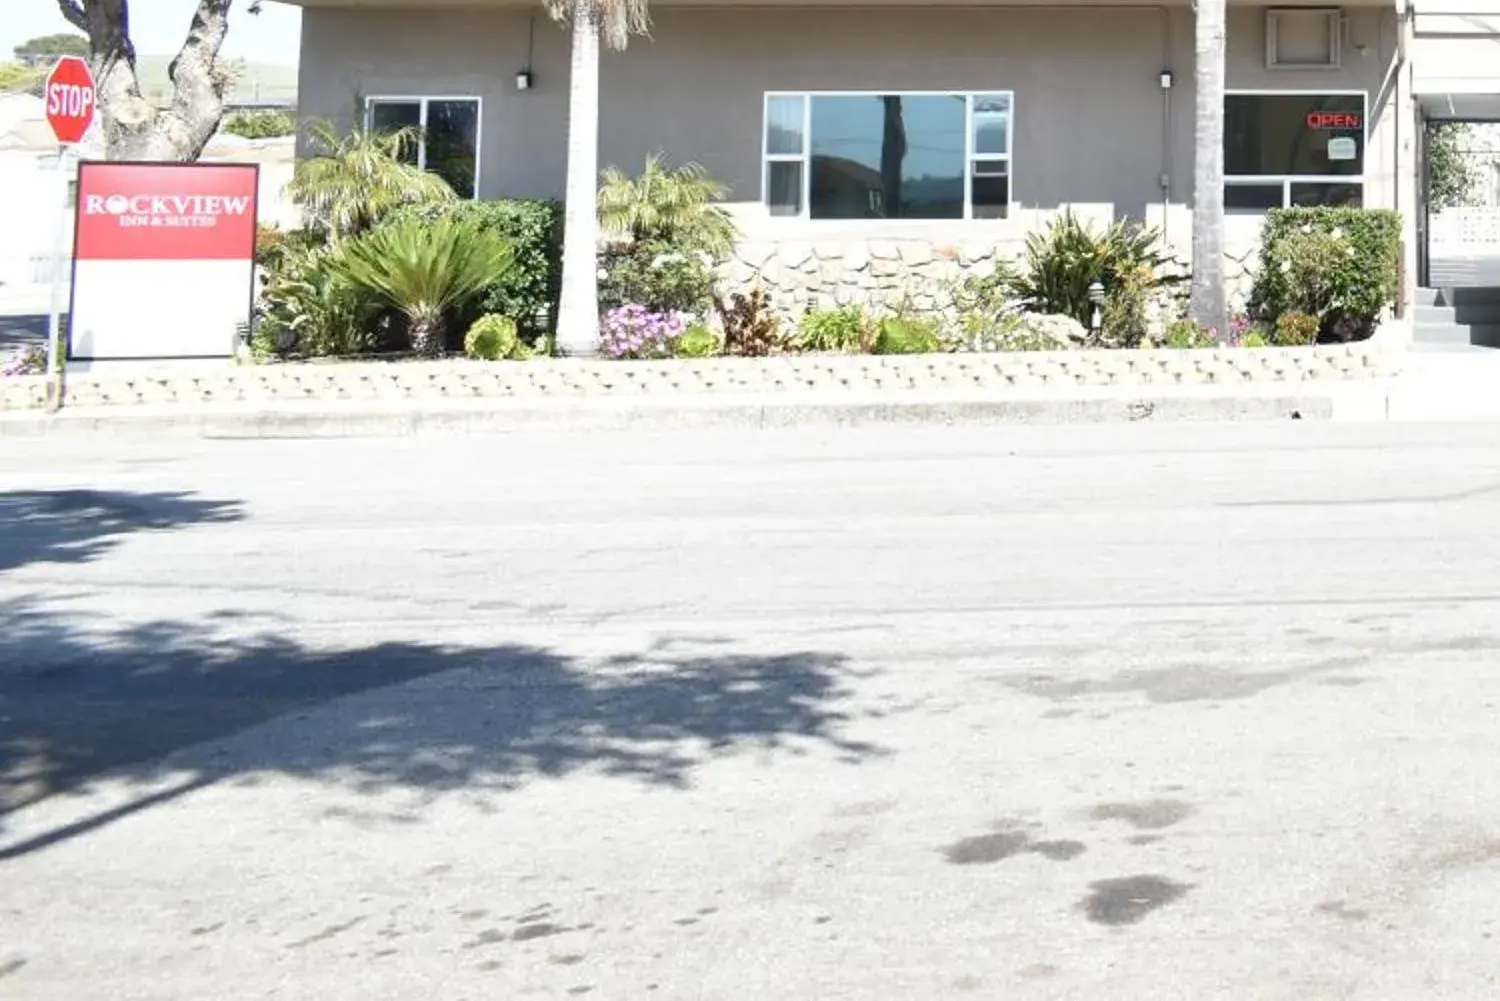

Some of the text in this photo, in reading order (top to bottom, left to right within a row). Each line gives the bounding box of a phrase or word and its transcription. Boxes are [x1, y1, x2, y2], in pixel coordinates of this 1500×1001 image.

[48, 82, 93, 118] STOP
[1307, 111, 1358, 128] OPEN
[85, 193, 250, 216] ROCKVIEW
